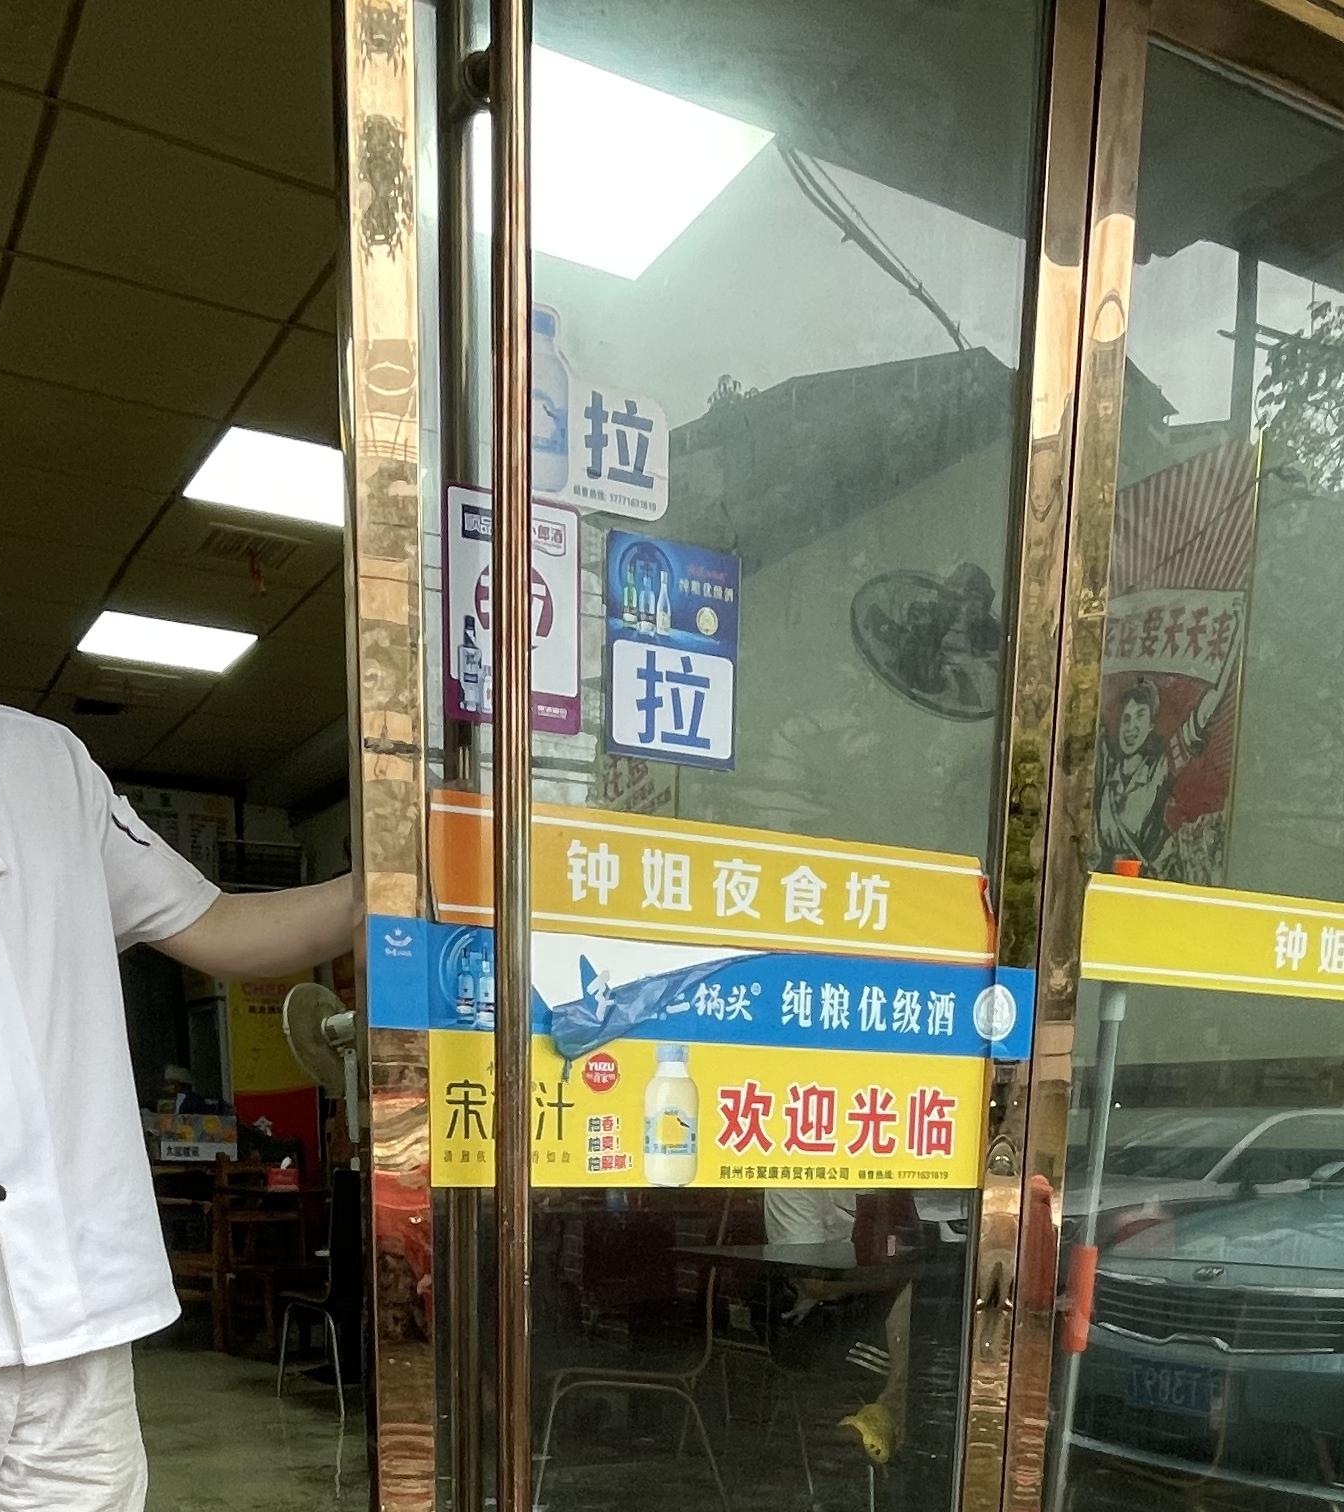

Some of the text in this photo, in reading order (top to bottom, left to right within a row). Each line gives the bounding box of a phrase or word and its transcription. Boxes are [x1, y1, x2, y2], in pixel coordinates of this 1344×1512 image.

[584, 391, 654, 489] 拉
[636, 650, 712, 750] 拉
[566, 838, 892, 932] 钟姐夜食坊
[782, 980, 957, 1037] 纯粮优级酒
[588, 1061, 615, 1072] YUZU
[445, 1079, 575, 1141] 宋汁
[717, 1081, 956, 1157] 欢迎光临
